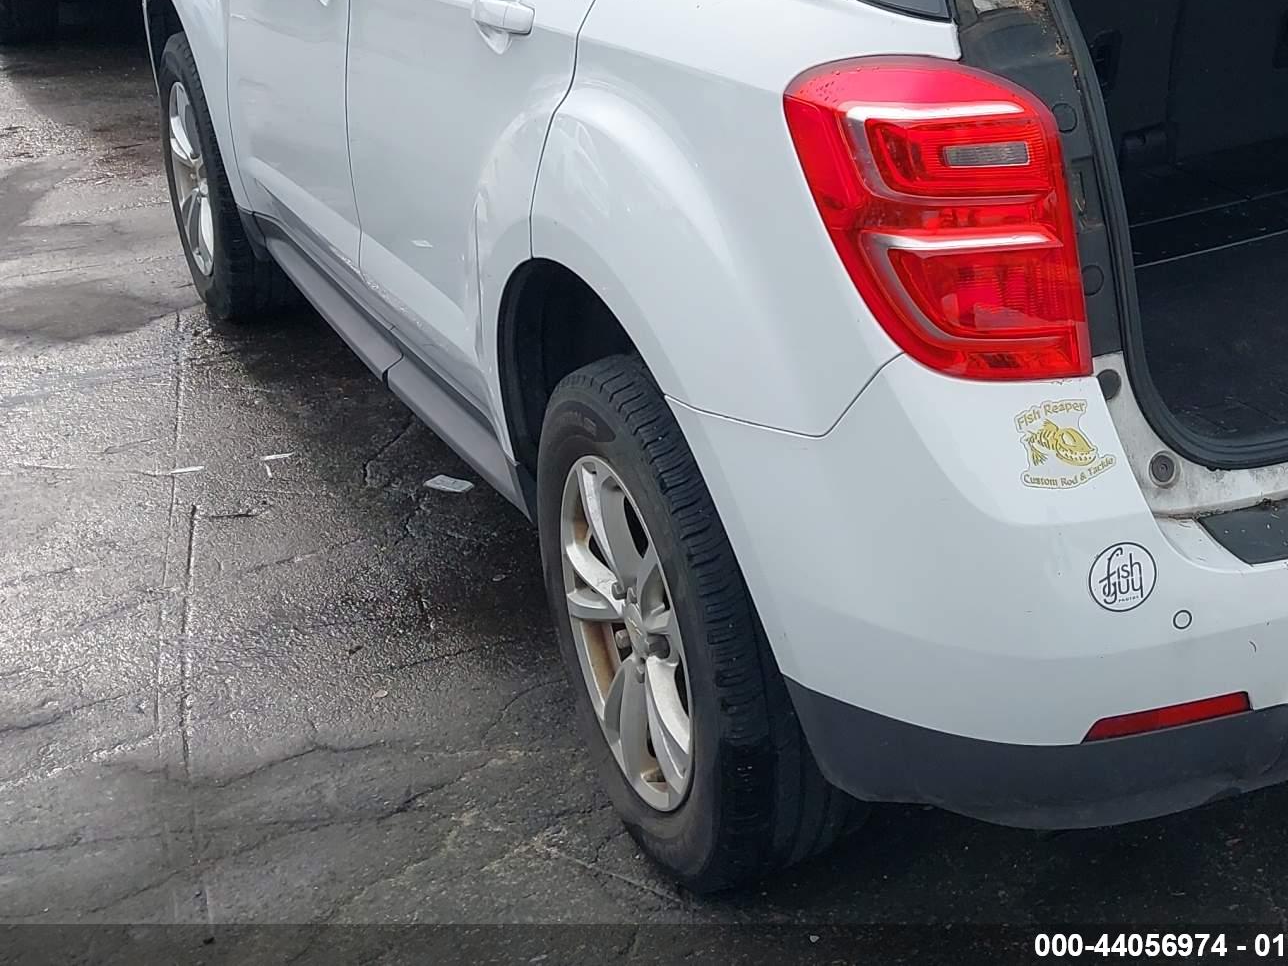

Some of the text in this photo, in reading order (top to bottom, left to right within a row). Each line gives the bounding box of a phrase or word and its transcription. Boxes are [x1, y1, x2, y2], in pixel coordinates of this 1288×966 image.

[1043, 402, 1085, 415] Reaper
[1023, 474, 1058, 486] Custom
[1060, 476, 1079, 487] Rod
[1087, 457, 1114, 476] Tackle
